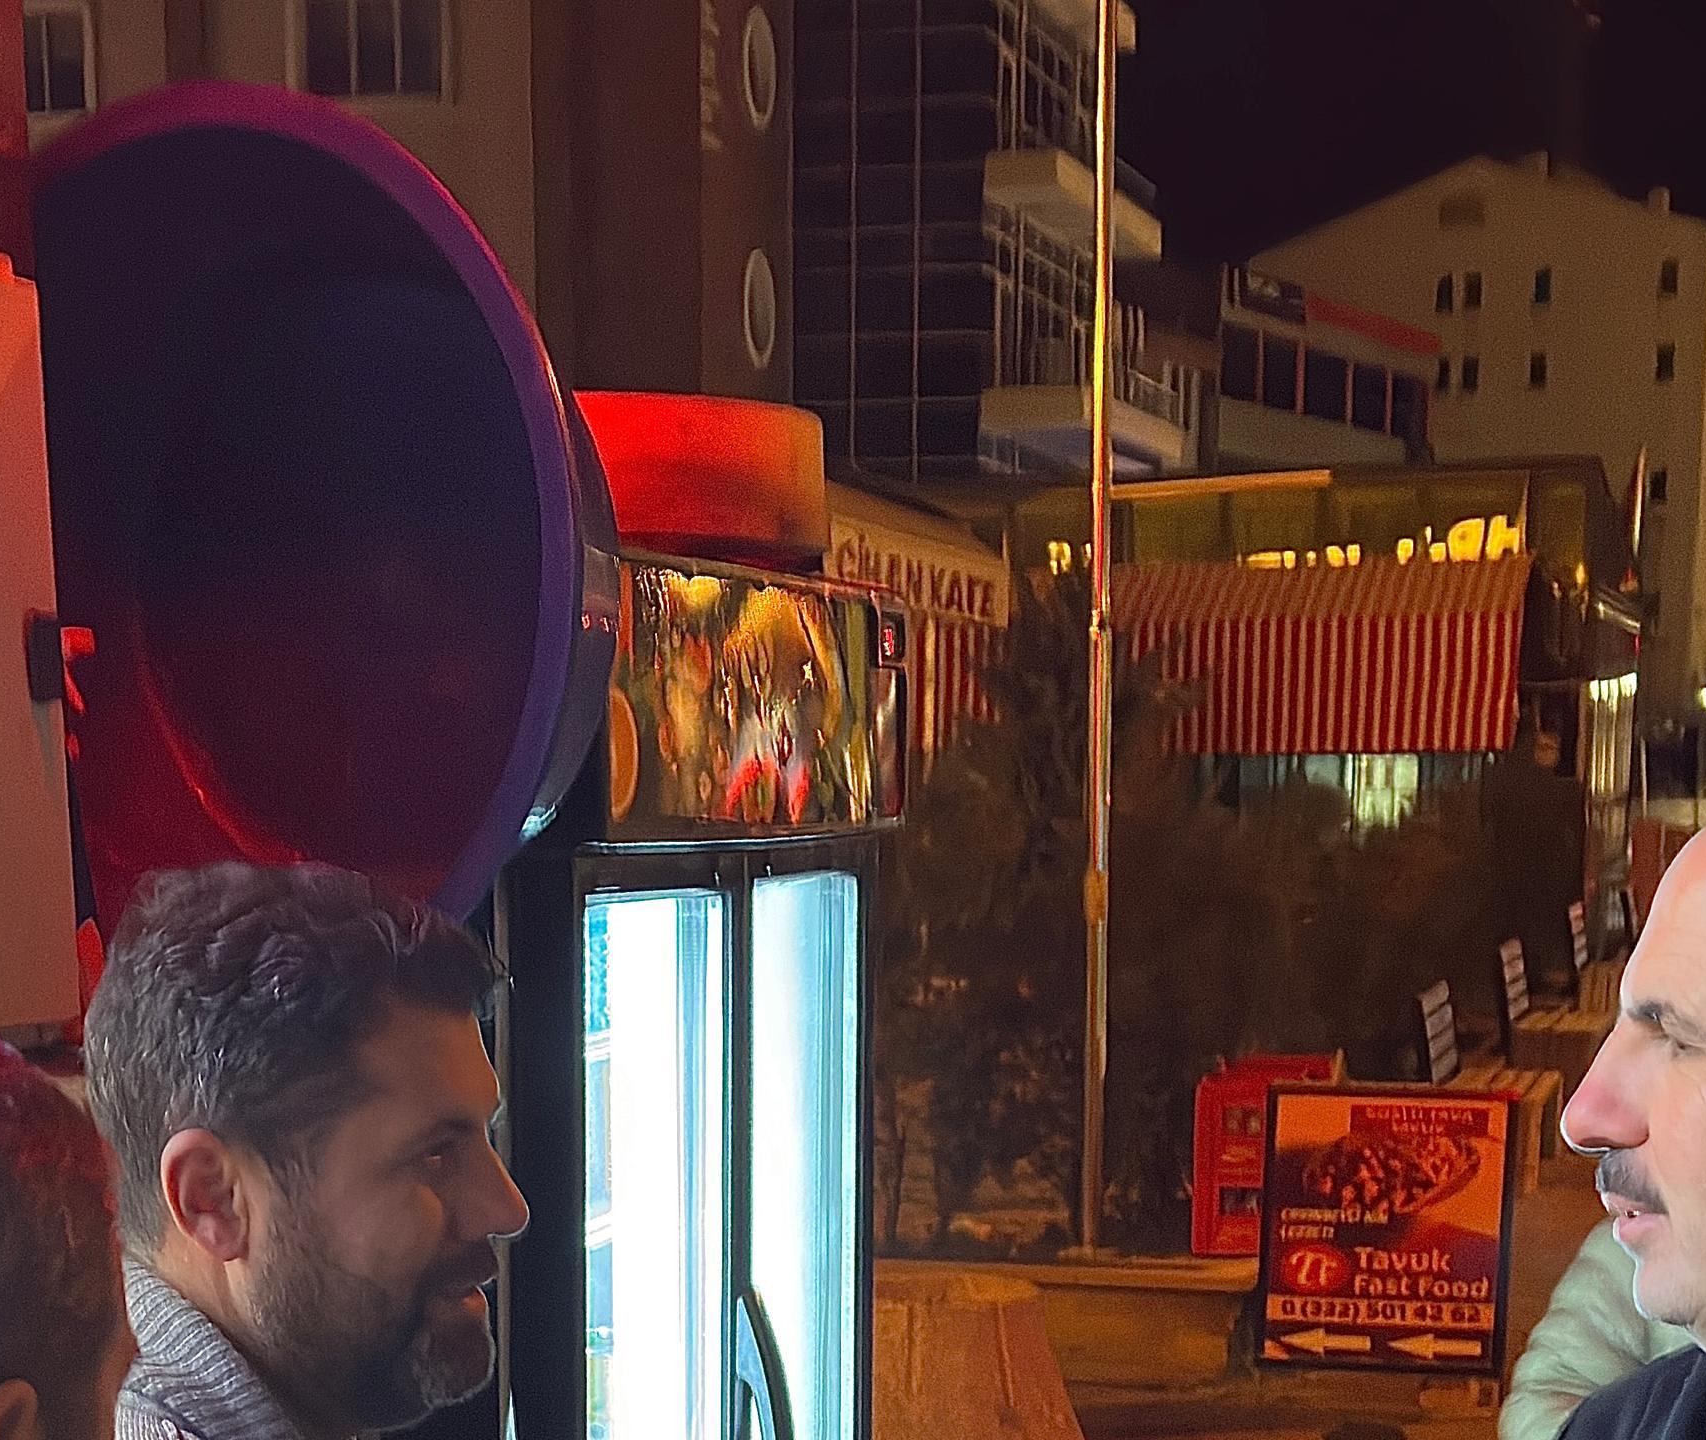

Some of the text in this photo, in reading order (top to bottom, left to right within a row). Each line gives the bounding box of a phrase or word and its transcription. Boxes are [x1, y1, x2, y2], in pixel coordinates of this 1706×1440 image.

[1354, 1246, 1451, 1274] Tavuk
[1354, 1273, 1490, 1299] Fast Food
